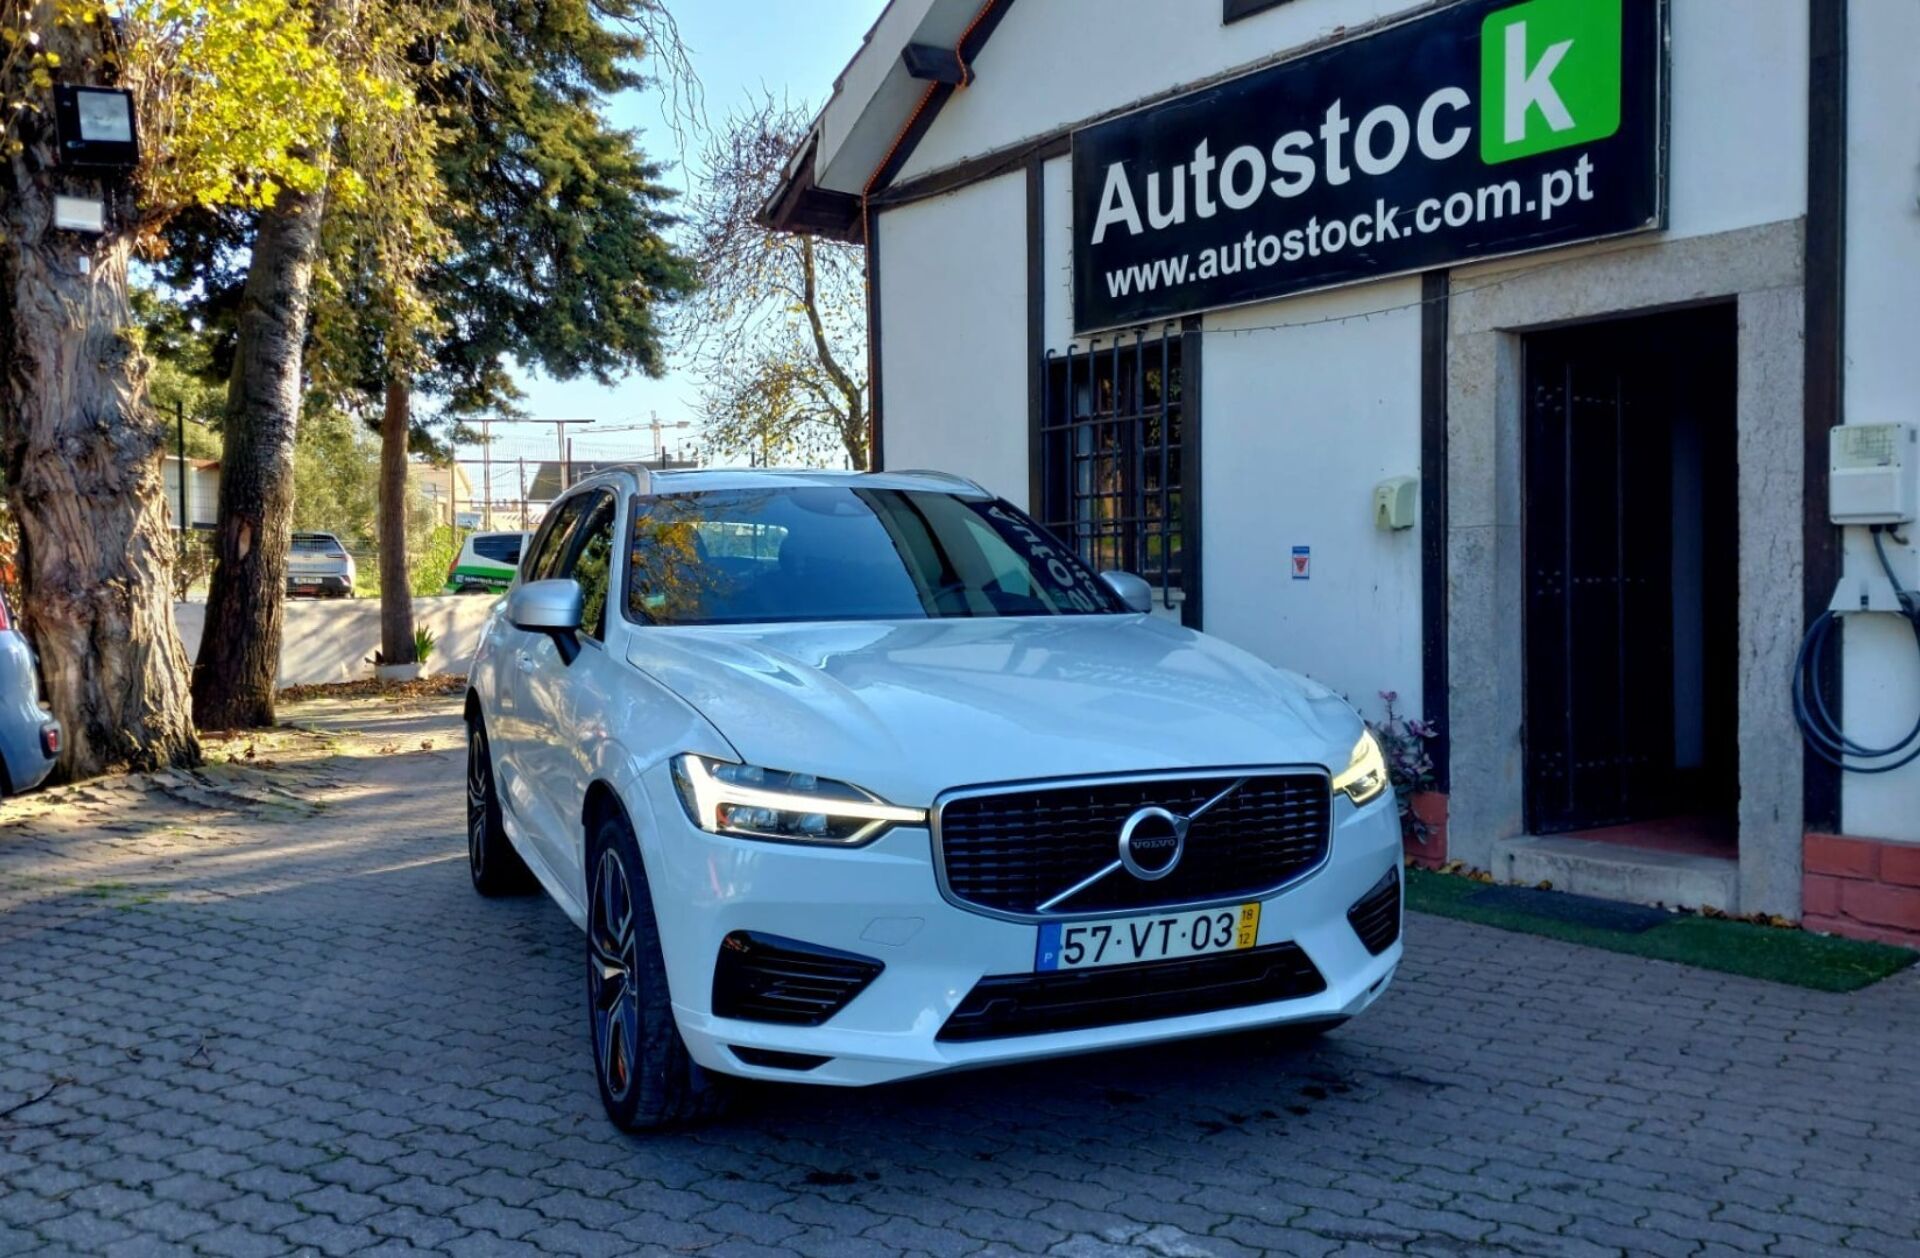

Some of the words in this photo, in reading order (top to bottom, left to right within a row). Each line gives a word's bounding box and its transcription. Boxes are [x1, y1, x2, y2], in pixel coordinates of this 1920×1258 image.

[1091, 20, 1577, 245] Autostock
[1105, 153, 1595, 298] www.autostock.com.pt
[1131, 839, 1175, 849] VOLVO
[1242, 908, 1254, 921] 18
[1239, 933, 1250, 945] 12
[1044, 952, 1053, 963] P
